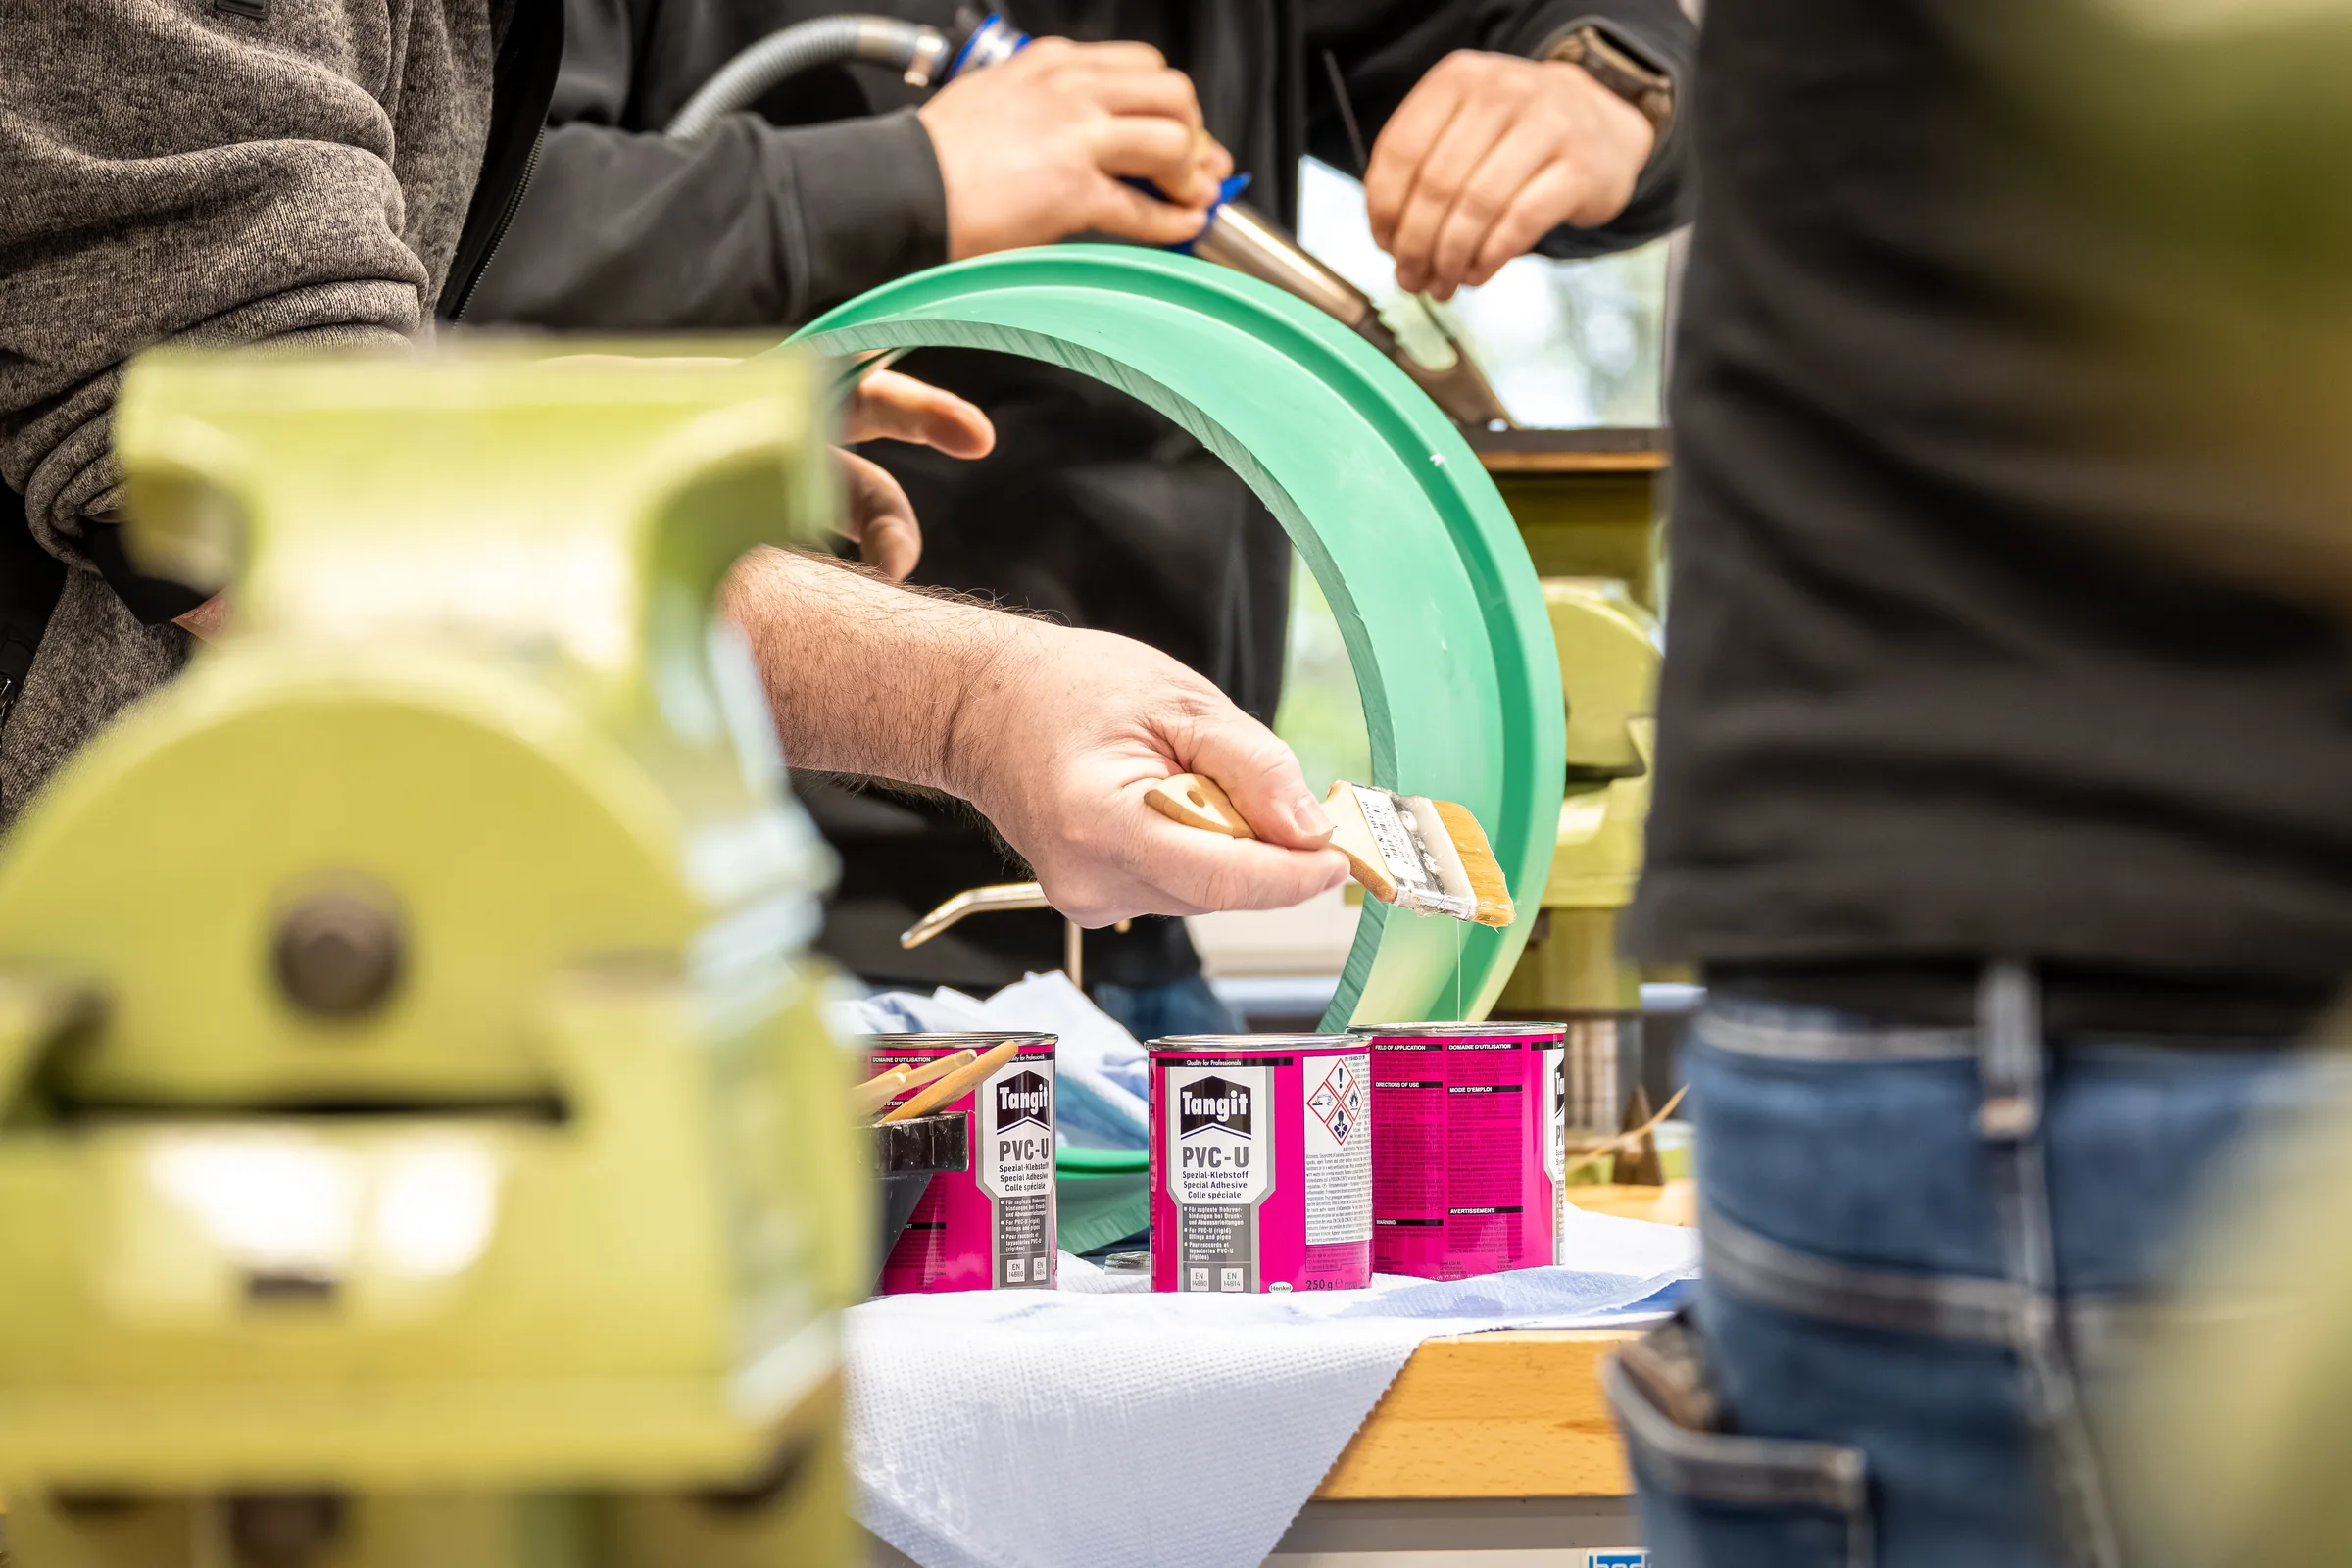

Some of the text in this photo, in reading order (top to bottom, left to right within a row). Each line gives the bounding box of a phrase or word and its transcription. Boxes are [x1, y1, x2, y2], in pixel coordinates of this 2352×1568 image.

[999, 1083, 1048, 1115] Tangit
[1182, 1090, 1248, 1122] Tangit
[999, 1138, 1049, 1162] PVC-U
[1182, 1146, 1250, 1168] PVC-U
[1000, 1173, 1025, 1183] Special
[1182, 1170, 1249, 1180] Spezial-Klebstoff
[1004, 1183, 1023, 1192] Colle
[1210, 1180, 1248, 1189] Adhesive
[1188, 1190, 1242, 1200] Colle spéciale
[1305, 1279, 1326, 1291] 250
[1327, 1282, 1333, 1291] g
